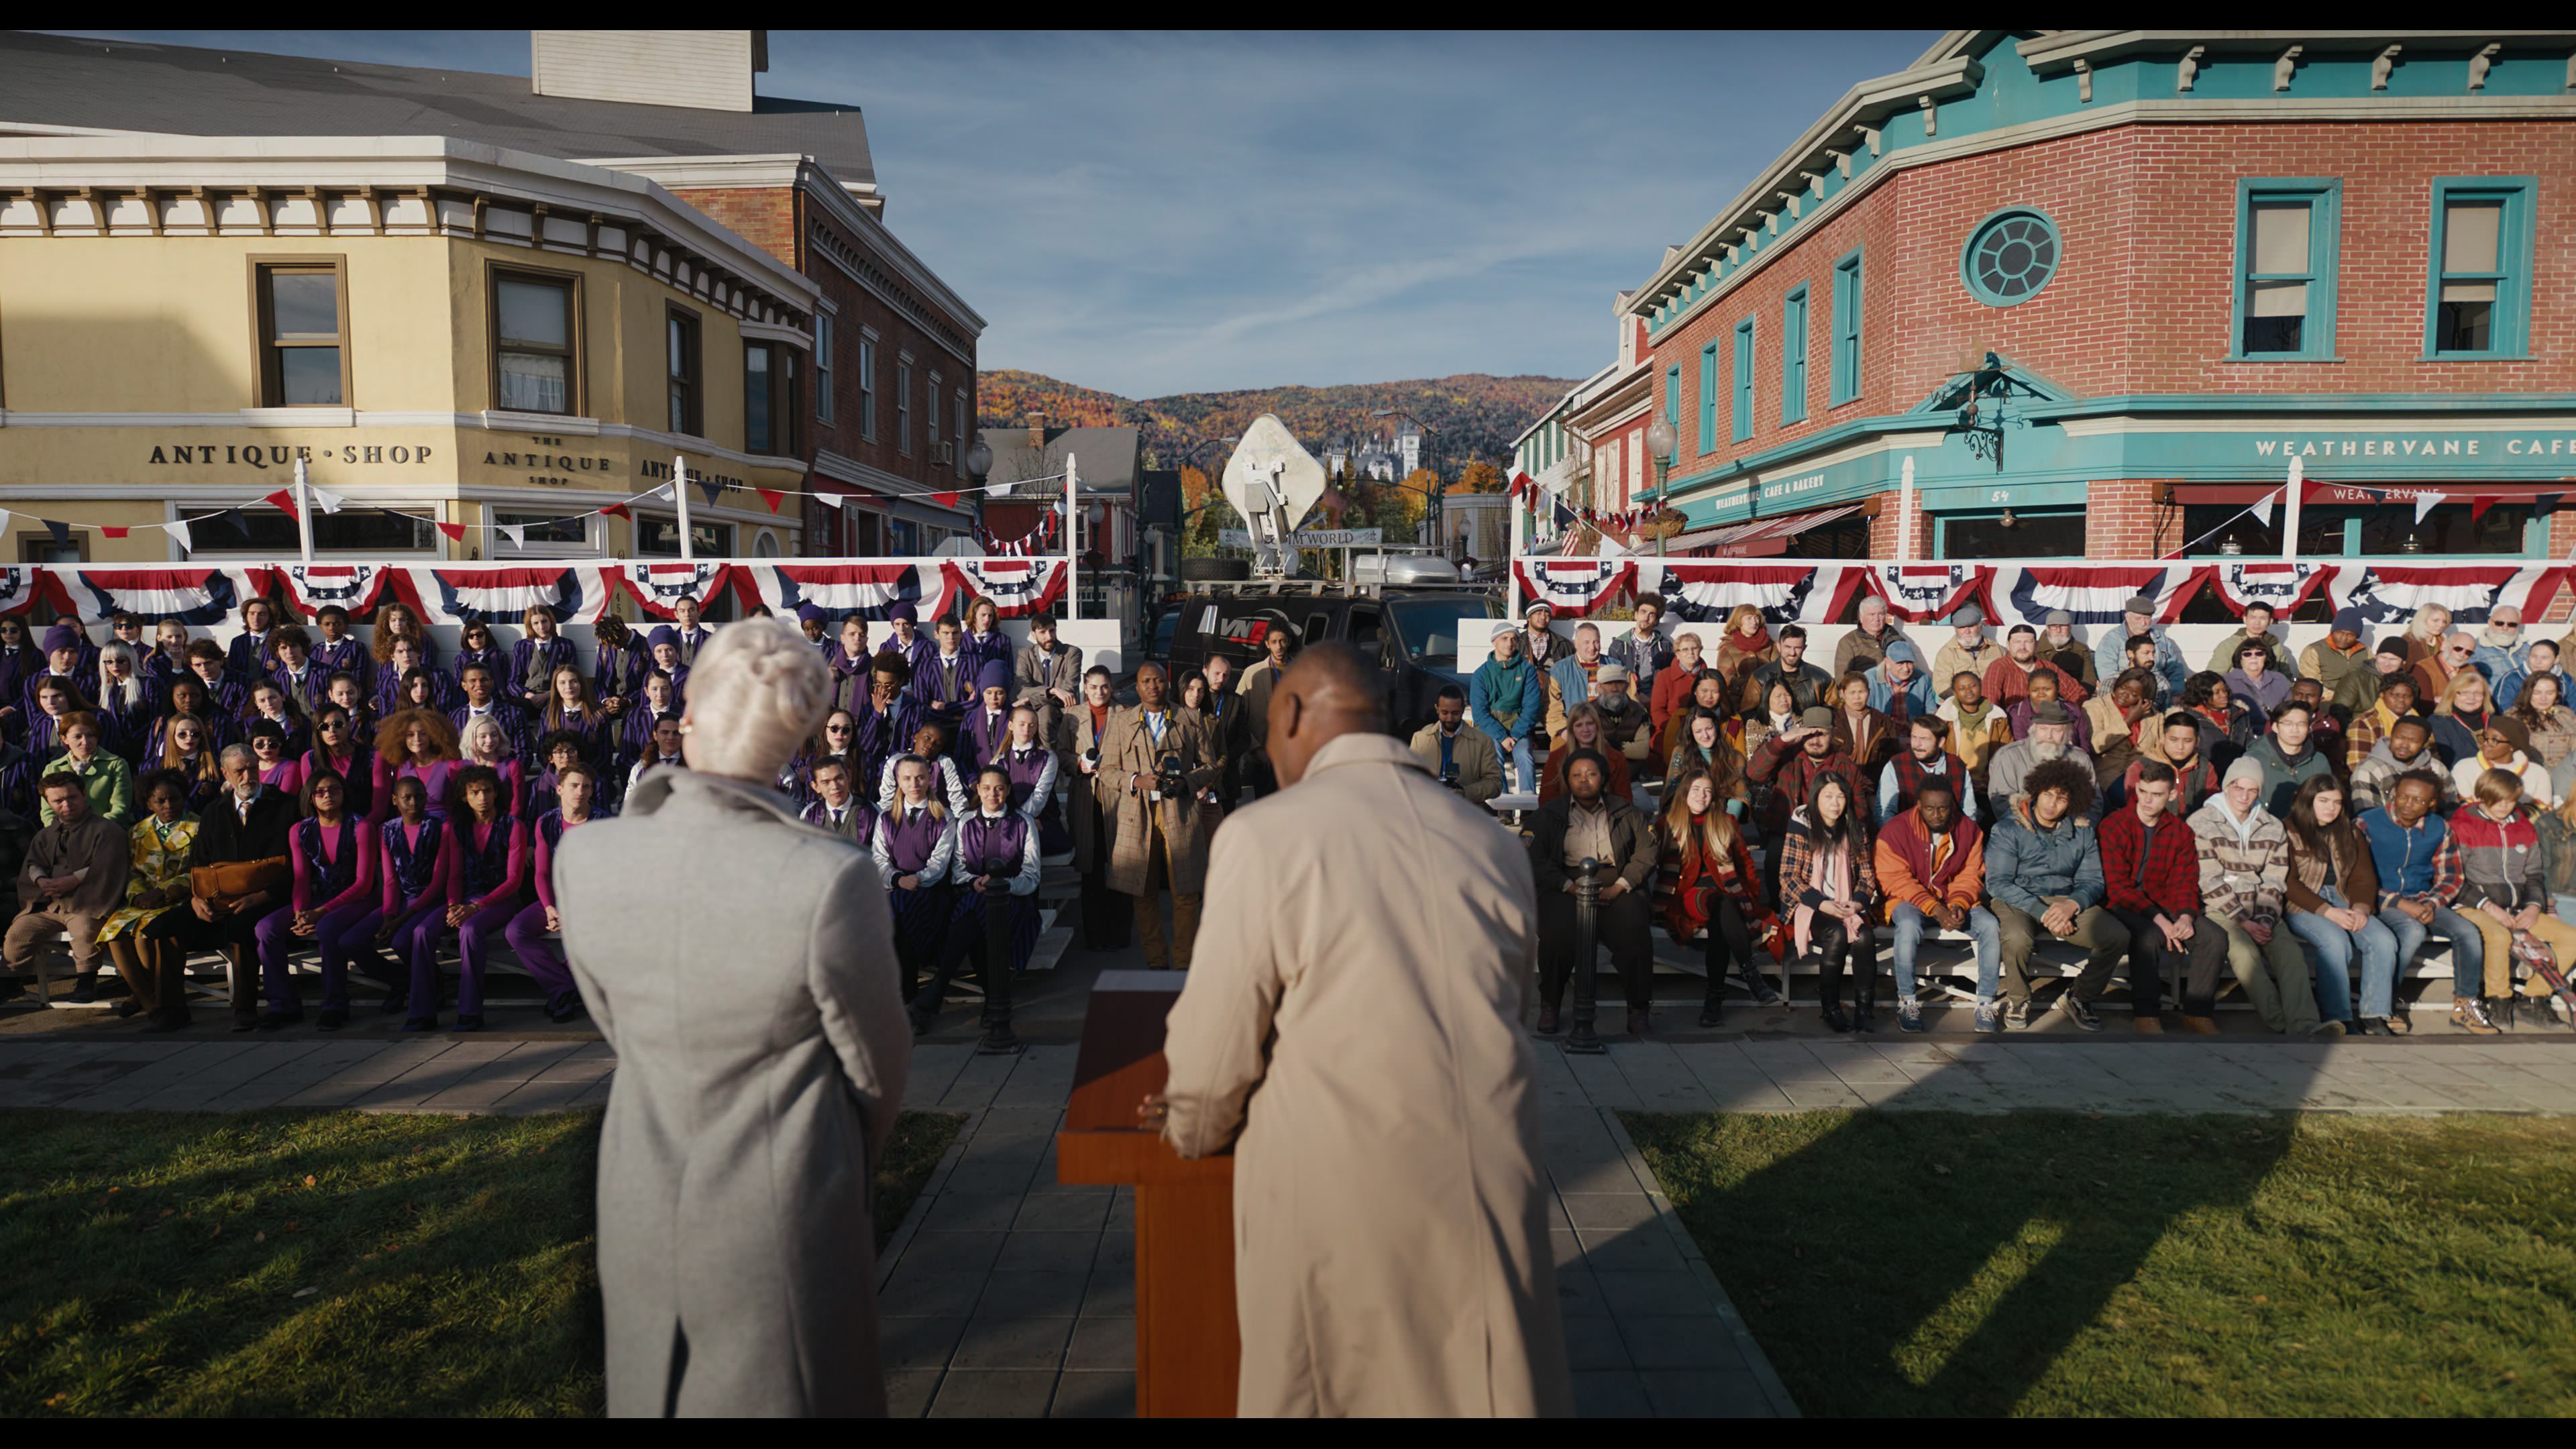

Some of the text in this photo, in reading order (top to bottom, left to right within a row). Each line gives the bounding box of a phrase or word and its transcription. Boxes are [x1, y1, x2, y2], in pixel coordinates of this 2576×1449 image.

[532, 437, 561, 445] THE
[2256, 440, 2480, 456] WEATHERVANE
[148, 445, 433, 469] ANTIQUE SHOP
[483, 451, 610, 472] ANTIQUE
[641, 460, 702, 484] ANTIUE
[529, 476, 568, 485] SHOP
[1716, 490, 1760, 510] WEATHERVANE
[1764, 484, 1783, 498] CAFE
[1793, 474, 1824, 492] BAKERY
[1991, 490, 2010, 502] 54
[1308, 532, 1354, 545] WORLD
